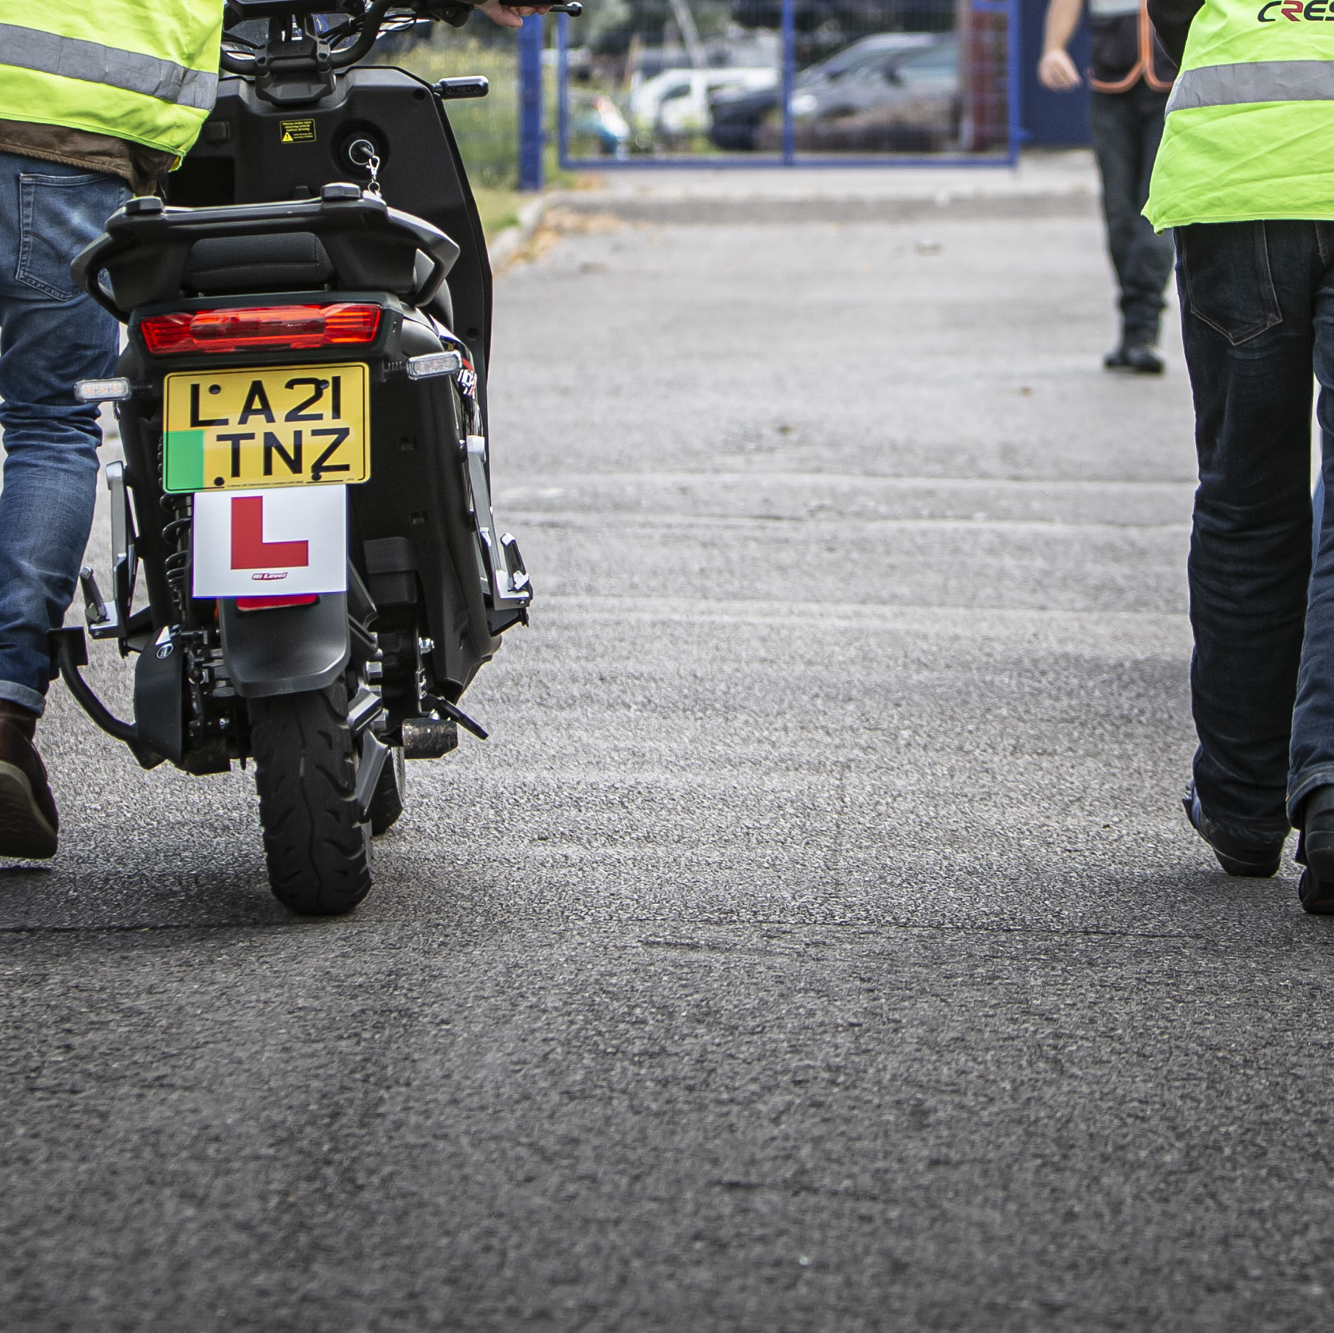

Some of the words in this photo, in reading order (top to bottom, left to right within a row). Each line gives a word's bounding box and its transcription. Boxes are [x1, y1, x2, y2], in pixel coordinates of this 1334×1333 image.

[190, 375, 341, 427] LA21
[216, 427, 350, 477] TNZ
[230, 495, 309, 570] L
